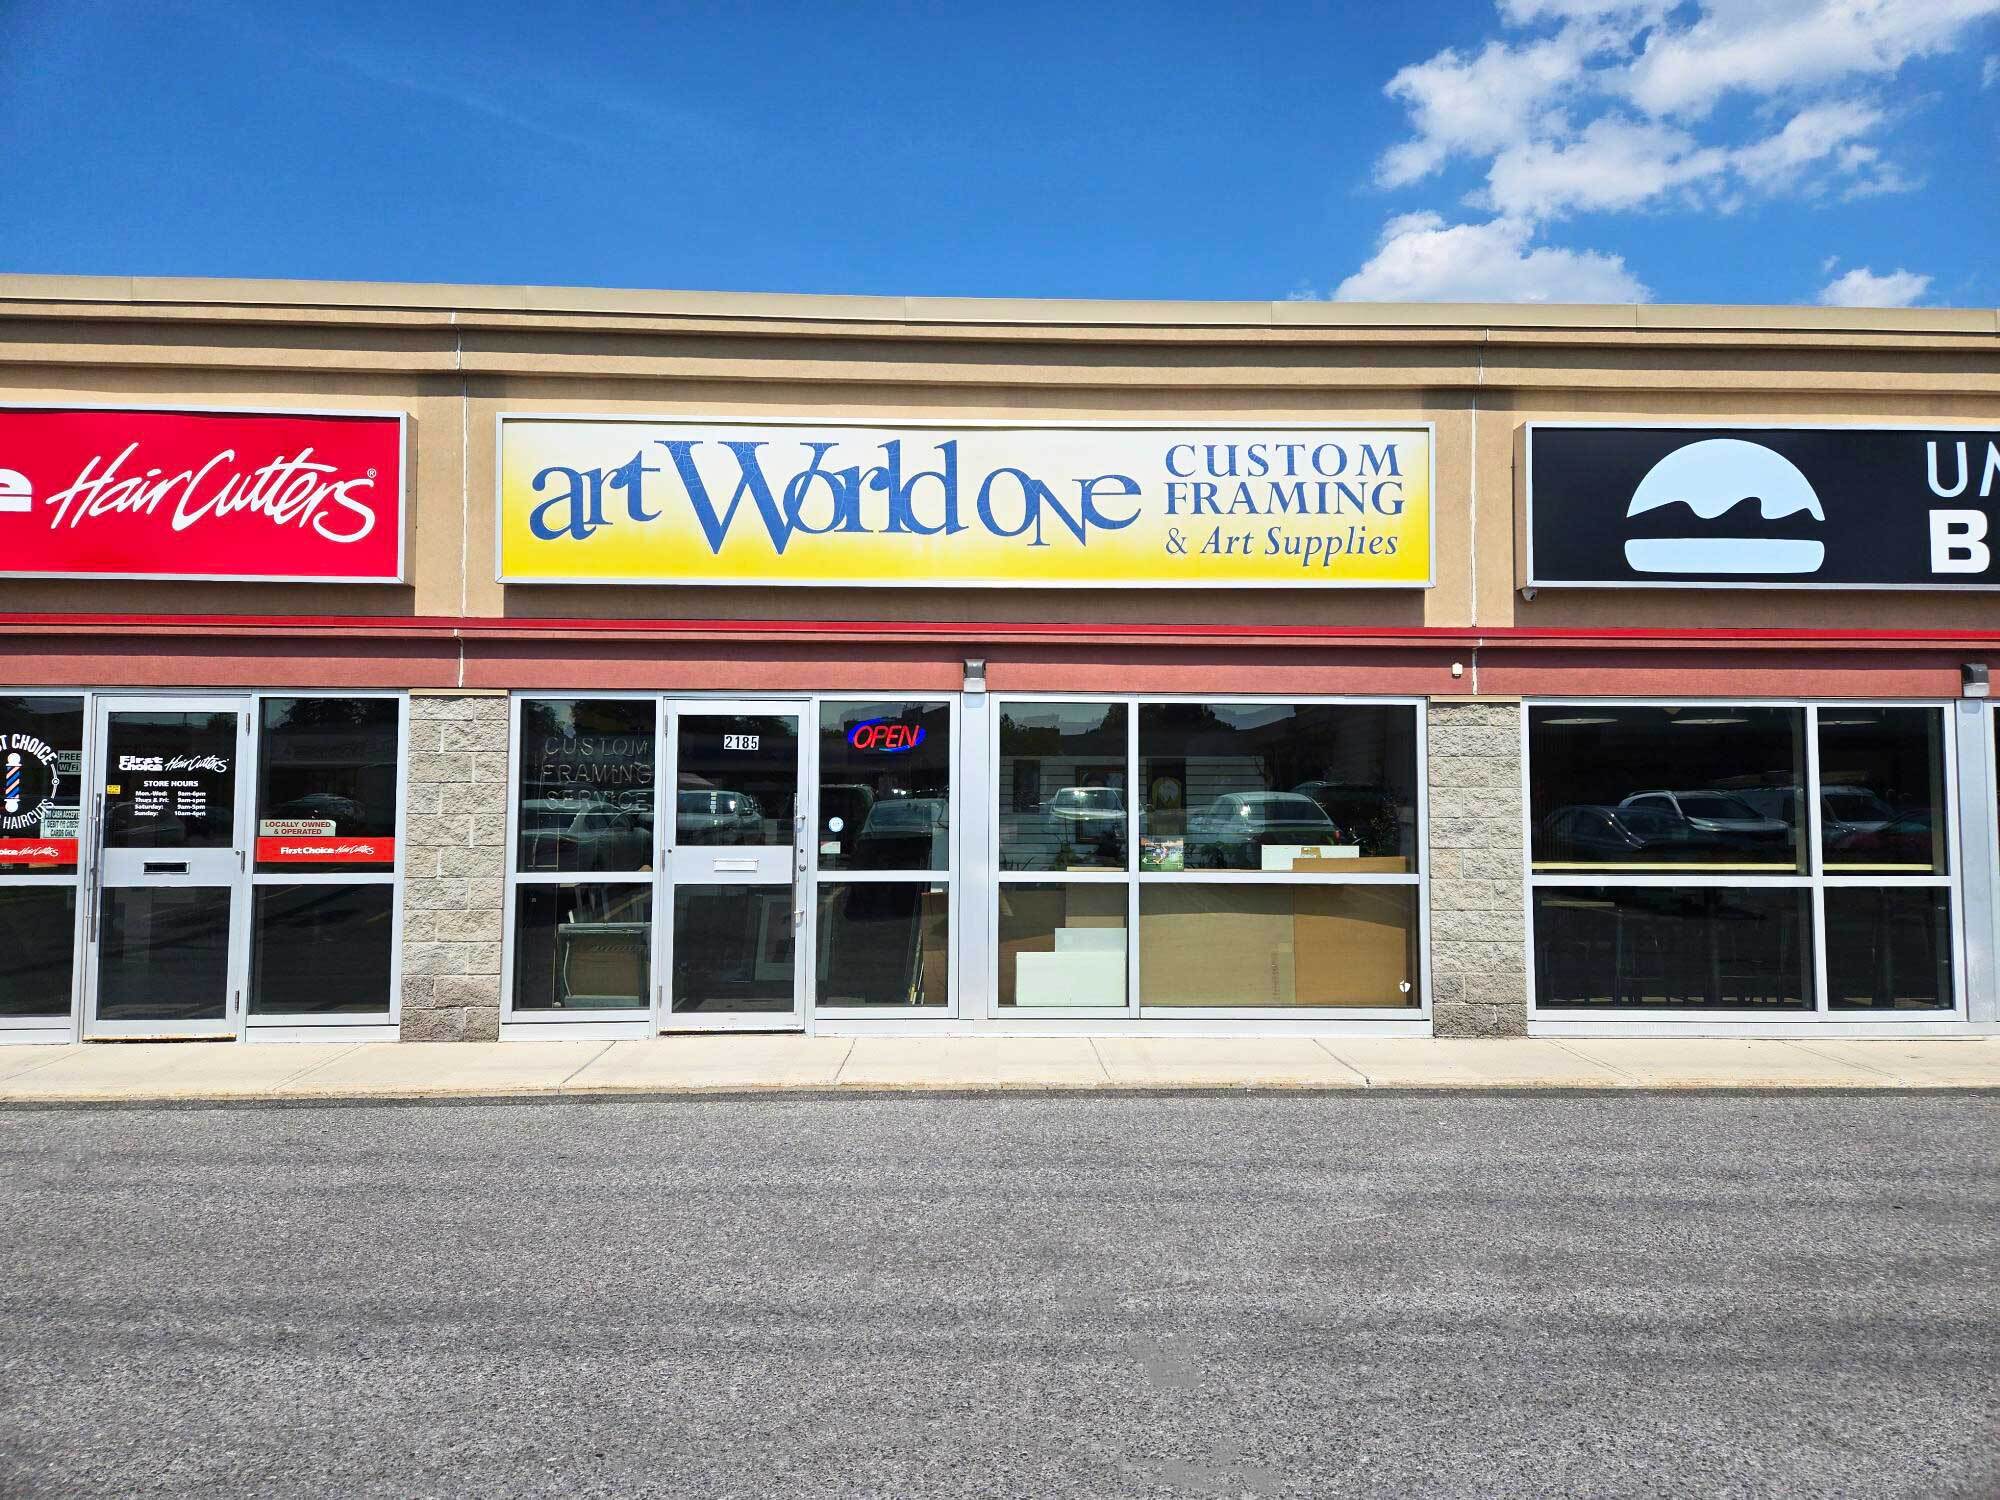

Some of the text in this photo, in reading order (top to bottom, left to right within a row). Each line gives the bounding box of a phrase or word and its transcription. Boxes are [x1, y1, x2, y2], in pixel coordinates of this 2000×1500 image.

[1165, 443, 1404, 478] CUSTOM
[529, 450, 662, 541] art
[653, 439, 969, 555] World
[1164, 481, 1405, 516] FRAMING
[1165, 526, 1398, 567] & Art Supplies
[11, 733, 58, 766] CHOICE
[545, 736, 648, 756] CUSTOM
[725, 736, 757, 749] 2185
[853, 725, 920, 749] OPEN
[59, 752, 81, 761] FREE
[2, 799, 55, 830] HAIRCUTS
